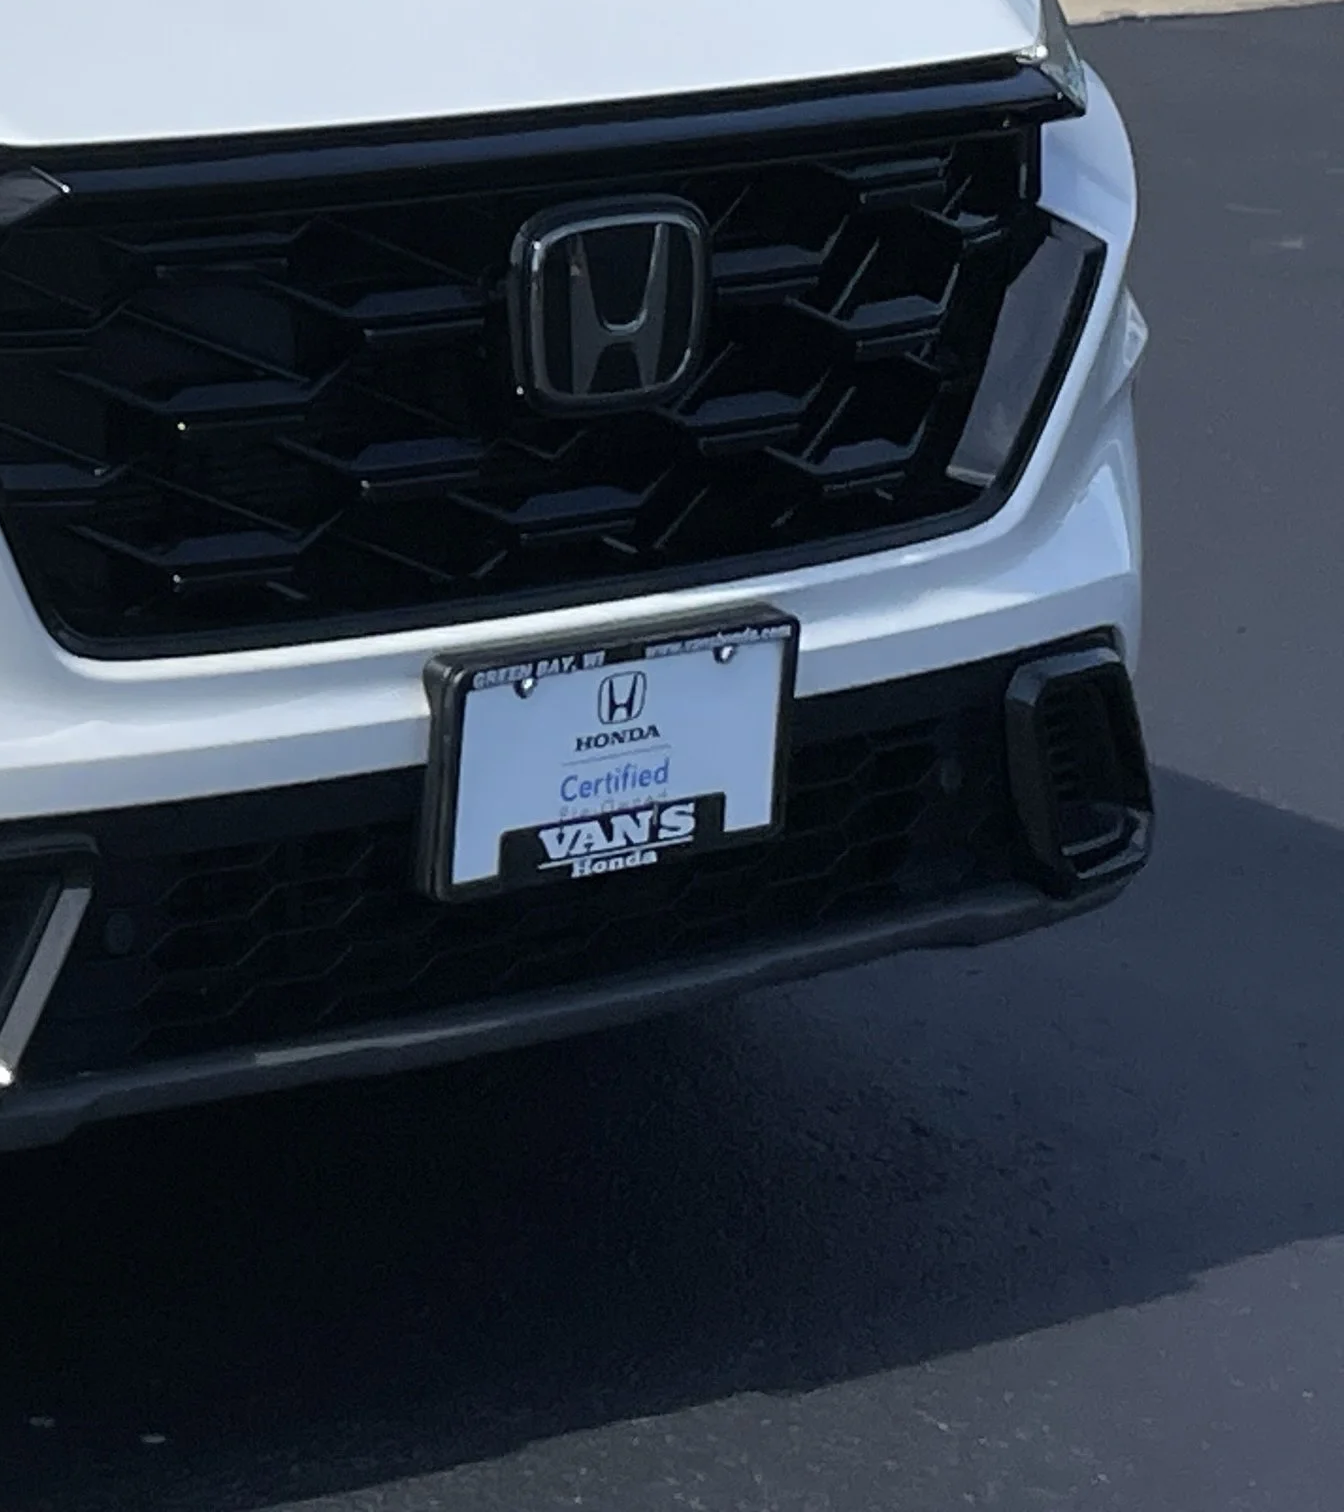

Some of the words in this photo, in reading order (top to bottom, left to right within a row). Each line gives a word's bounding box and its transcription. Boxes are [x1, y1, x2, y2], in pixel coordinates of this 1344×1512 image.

[473, 663, 533, 689] GREEN
[575, 724, 661, 752] HONDA
[559, 757, 670, 802] Certified
[571, 849, 658, 878] Honda
